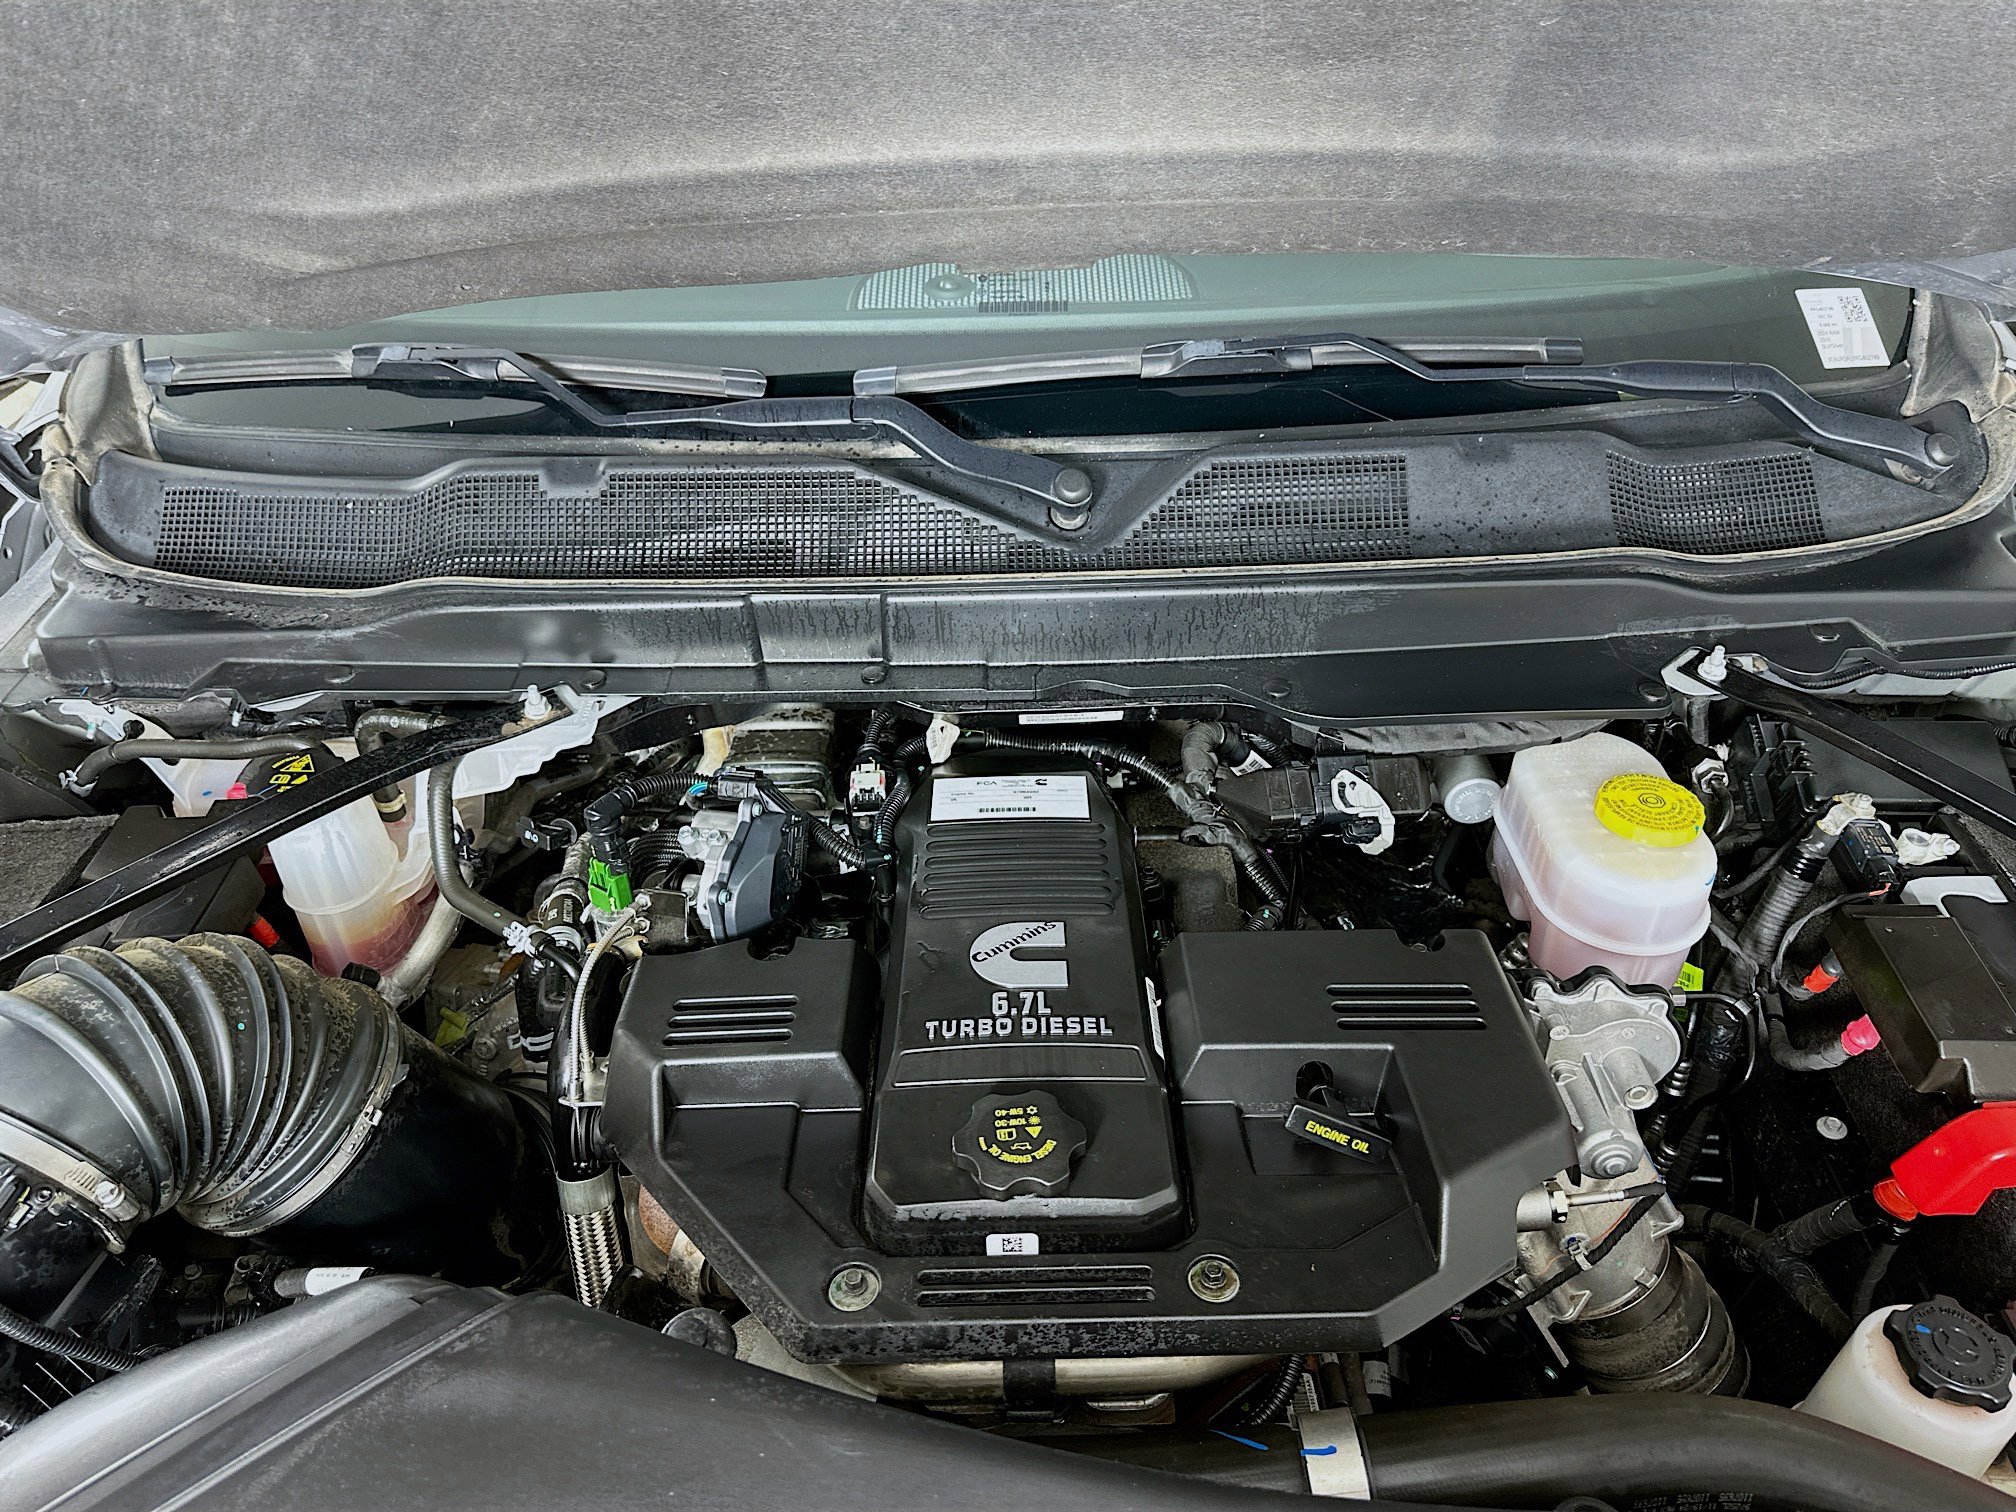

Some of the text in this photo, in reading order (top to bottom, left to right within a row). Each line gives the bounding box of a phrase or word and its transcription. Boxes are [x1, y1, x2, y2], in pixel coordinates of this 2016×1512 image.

[970, 919, 1057, 964] Cummins
[991, 990, 1052, 1018] 6.7L
[925, 1016, 1113, 1040] TURBO DIESEL
[994, 1107, 1024, 1116] 5W-40
[994, 1117, 1027, 1127] 10W-30
[1304, 1119, 1370, 1155] ENGINE OIL
[998, 1151, 1033, 1164] ENGINE
